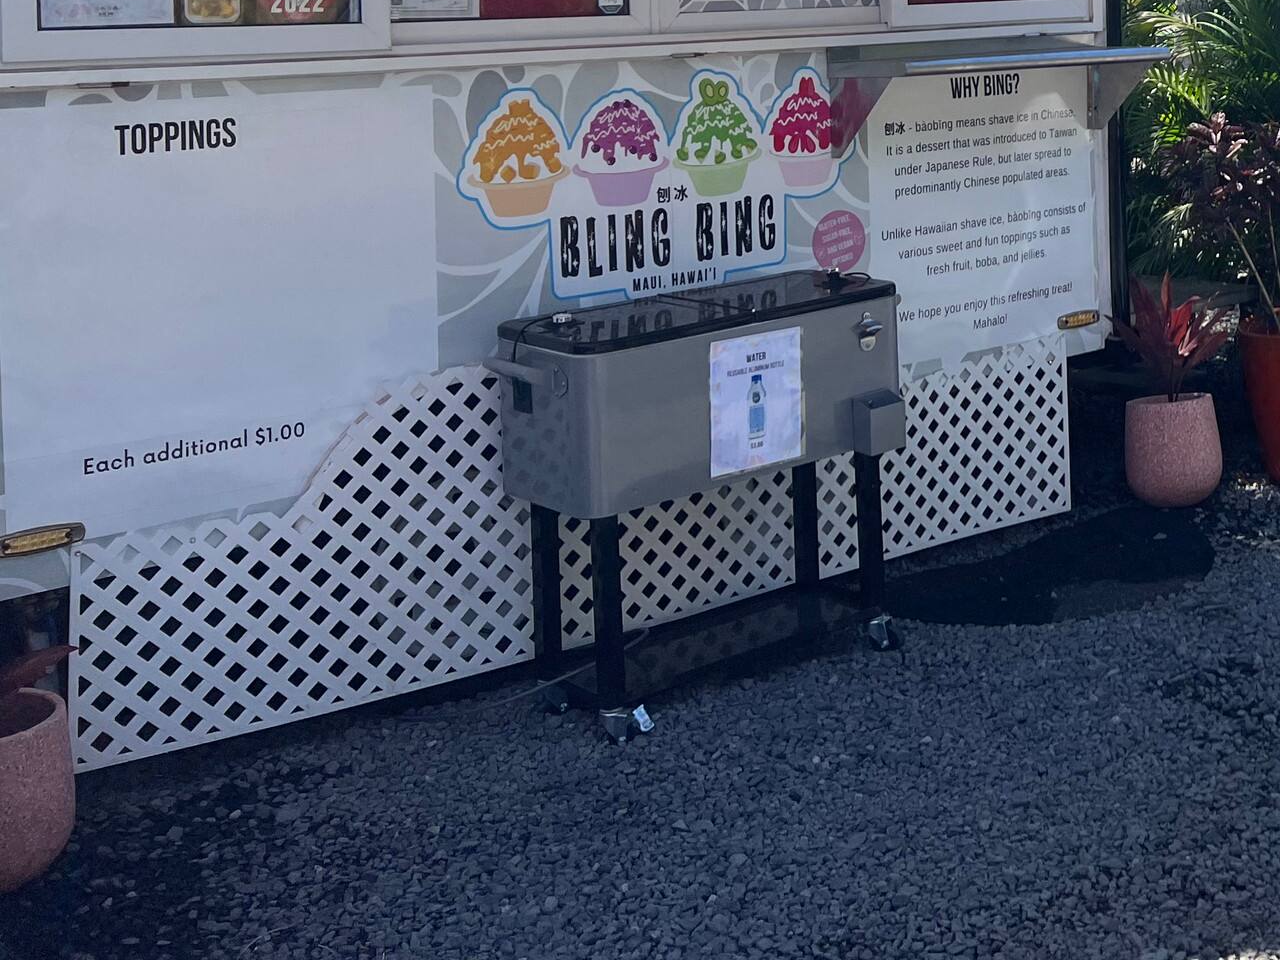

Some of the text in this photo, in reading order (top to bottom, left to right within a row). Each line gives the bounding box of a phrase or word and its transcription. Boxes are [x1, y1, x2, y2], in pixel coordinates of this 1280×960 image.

[951, 73, 1020, 99] WHY BING?
[956, 114, 986, 128] means
[989, 112, 1014, 126] shave
[1016, 112, 1029, 122] ice
[1031, 111, 1039, 121] in
[114, 118, 237, 156] TOPPINGS
[886, 128, 1077, 156] It is a dessert that was introduced to Taiwan
[895, 147, 1071, 176] under Japanese Rule, but later spread to
[894, 180, 961, 200] predominantly
[963, 176, 1000, 189] Chinese
[1002, 170, 1043, 186] populated
[559, 194, 776, 278] BLING BING
[881, 227, 912, 241] Unlike
[915, 221, 958, 238] Hawaiian
[960, 217, 987, 230] shave
[989, 215, 1004, 226] ice,
[1043, 205, 1076, 218] consists
[1078, 202, 1086, 213] of
[898, 225, 1071, 260] various sweet and fun toppings such as
[926, 261, 950, 276] fresh
[952, 257, 973, 272] fruit,
[975, 255, 999, 269] boba,
[1002, 251, 1019, 264] and
[899, 281, 1073, 323] We hope you enjoy this refreshing treat!
[973, 313, 1008, 330] Mahalo!
[746, 351, 766, 363] WATER
[83, 421, 305, 475] Each additional $1.00
